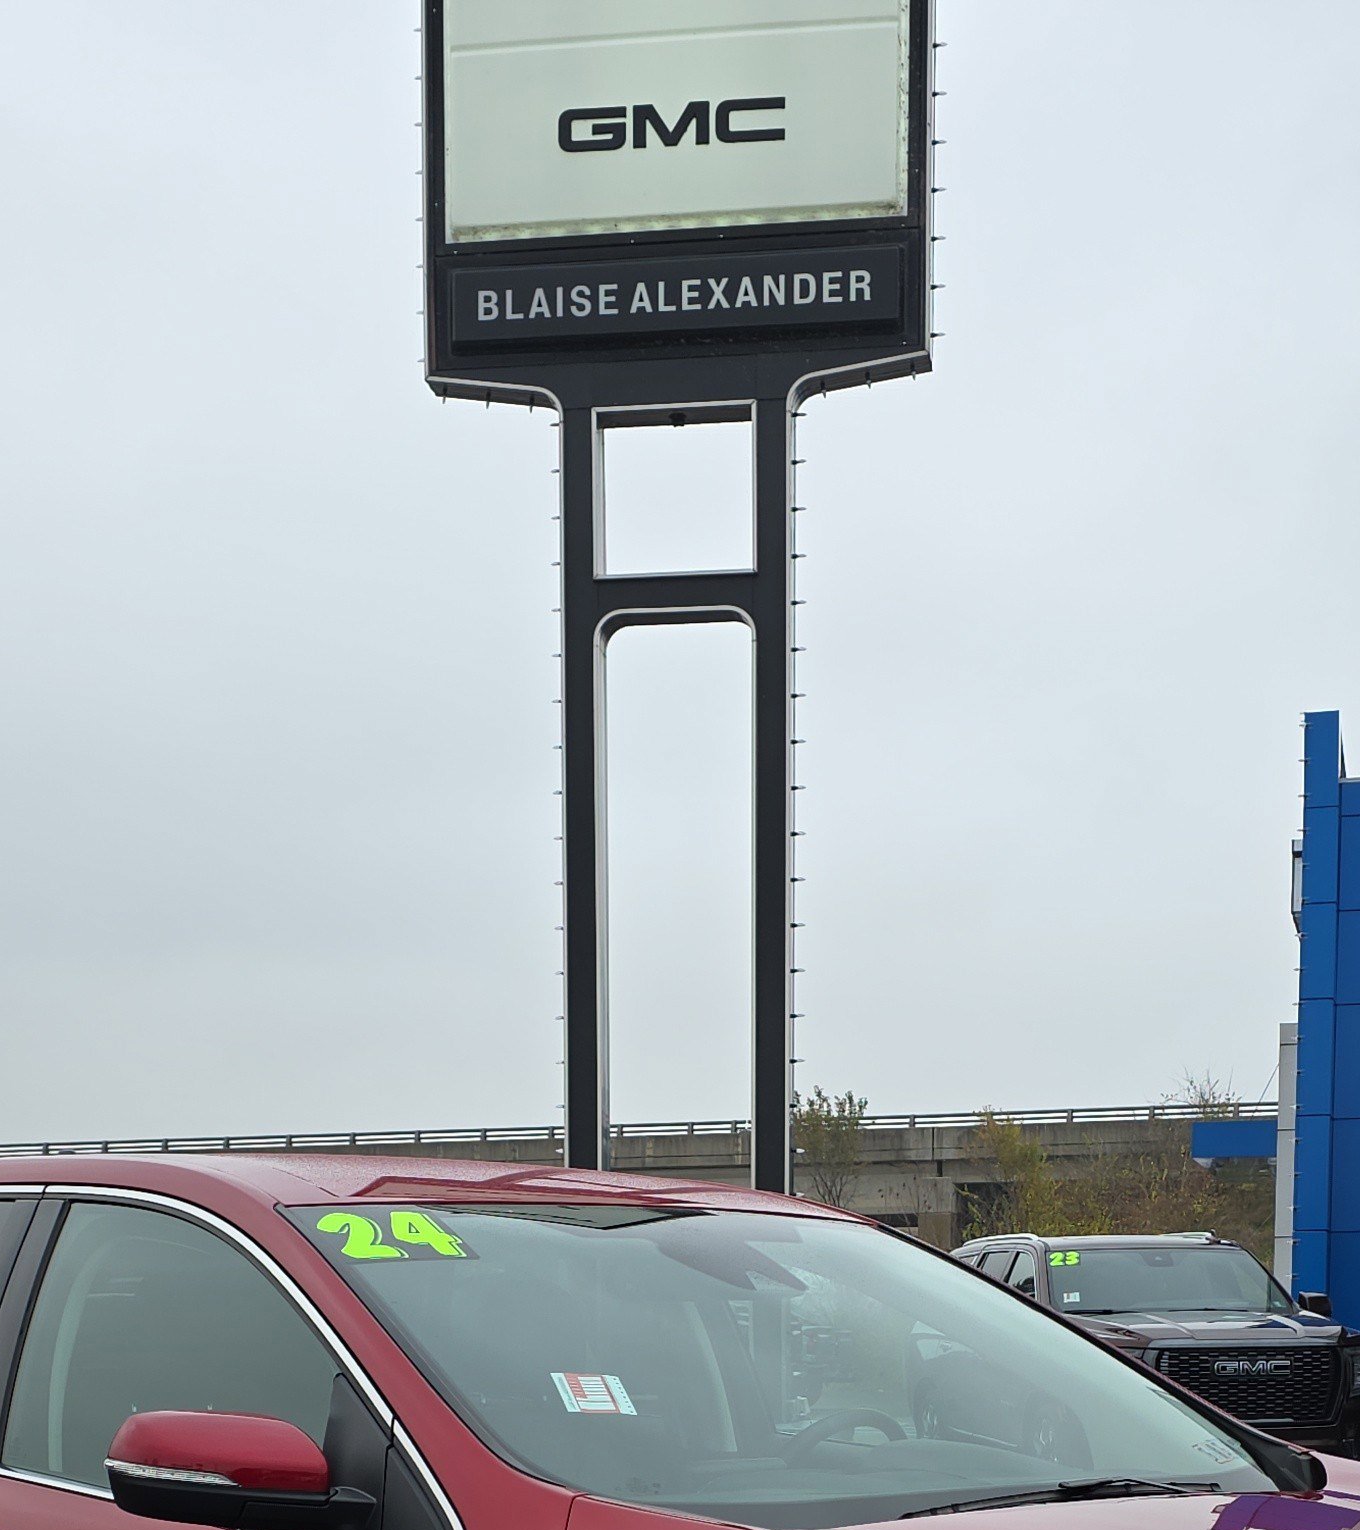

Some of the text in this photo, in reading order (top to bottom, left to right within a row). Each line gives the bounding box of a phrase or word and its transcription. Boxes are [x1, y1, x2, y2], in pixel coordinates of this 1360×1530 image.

[558, 97, 786, 152] GMC
[477, 270, 872, 321] BLAISE ALEXANDER
[316, 1210, 467, 1260] 24
[1214, 1360, 1291, 1376] GMC
